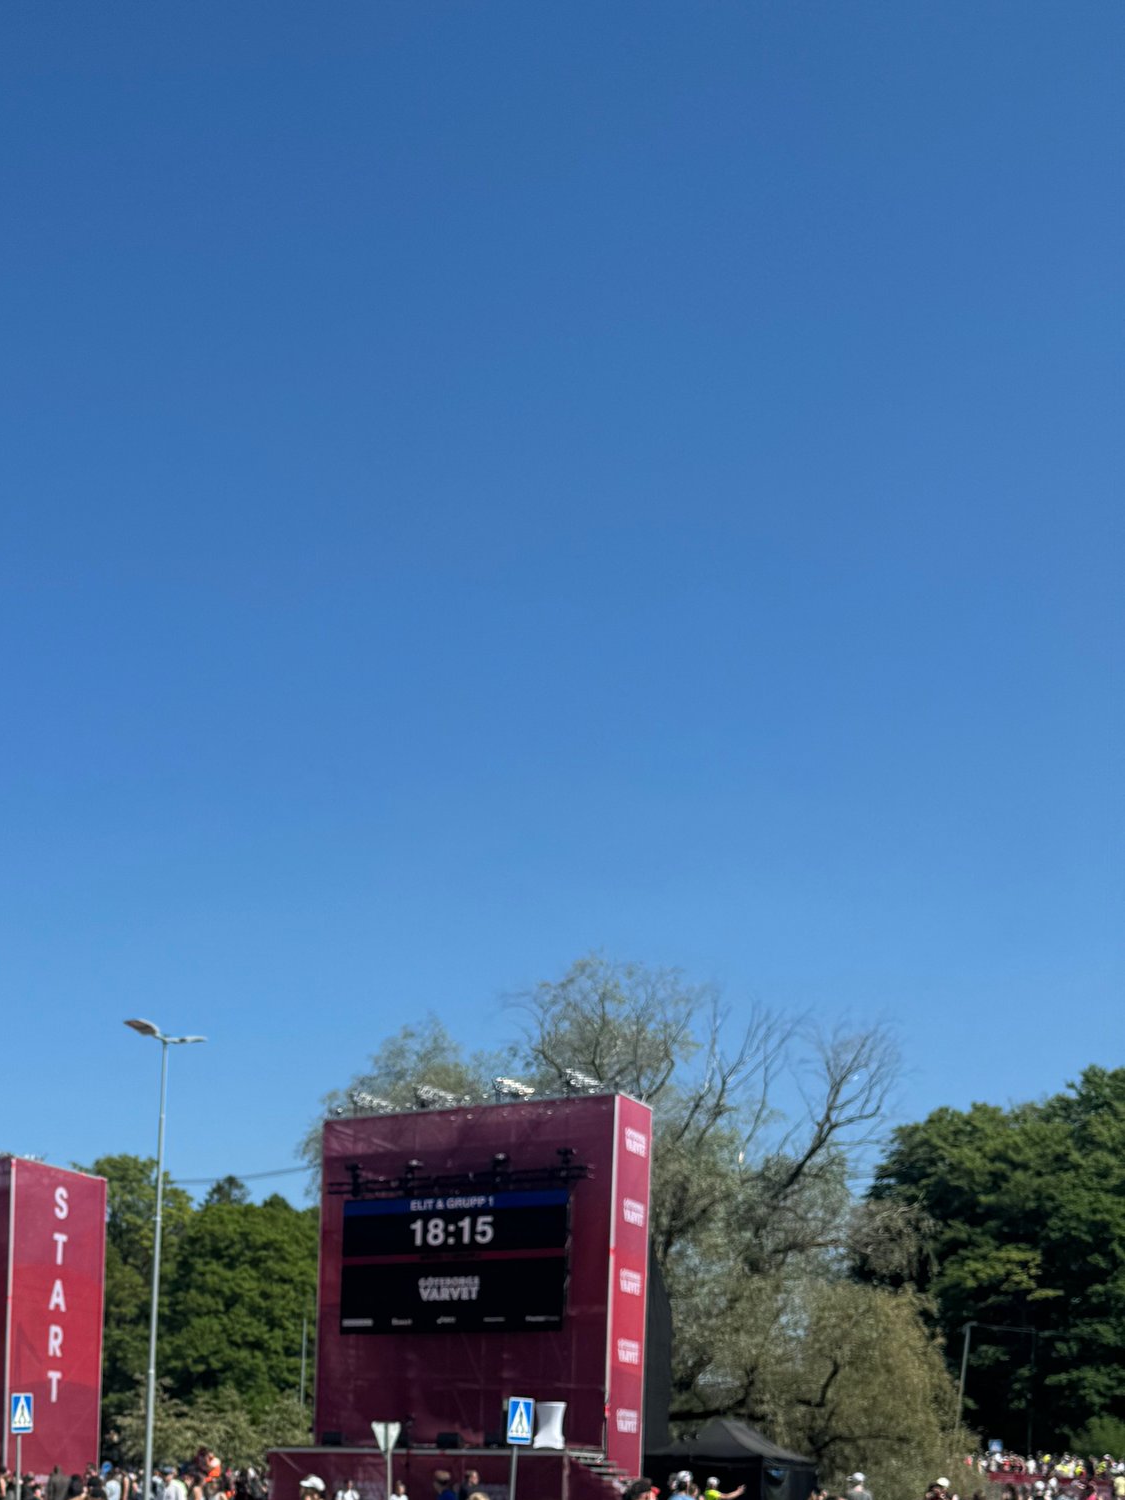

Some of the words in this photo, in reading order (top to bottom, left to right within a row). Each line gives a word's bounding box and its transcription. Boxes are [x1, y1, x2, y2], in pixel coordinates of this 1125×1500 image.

[410, 1199, 434, 1211] ELIT
[410, 1215, 494, 1247] 18:15
[47, 1186, 69, 1403] START
[419, 1286, 478, 1302] VARVET
